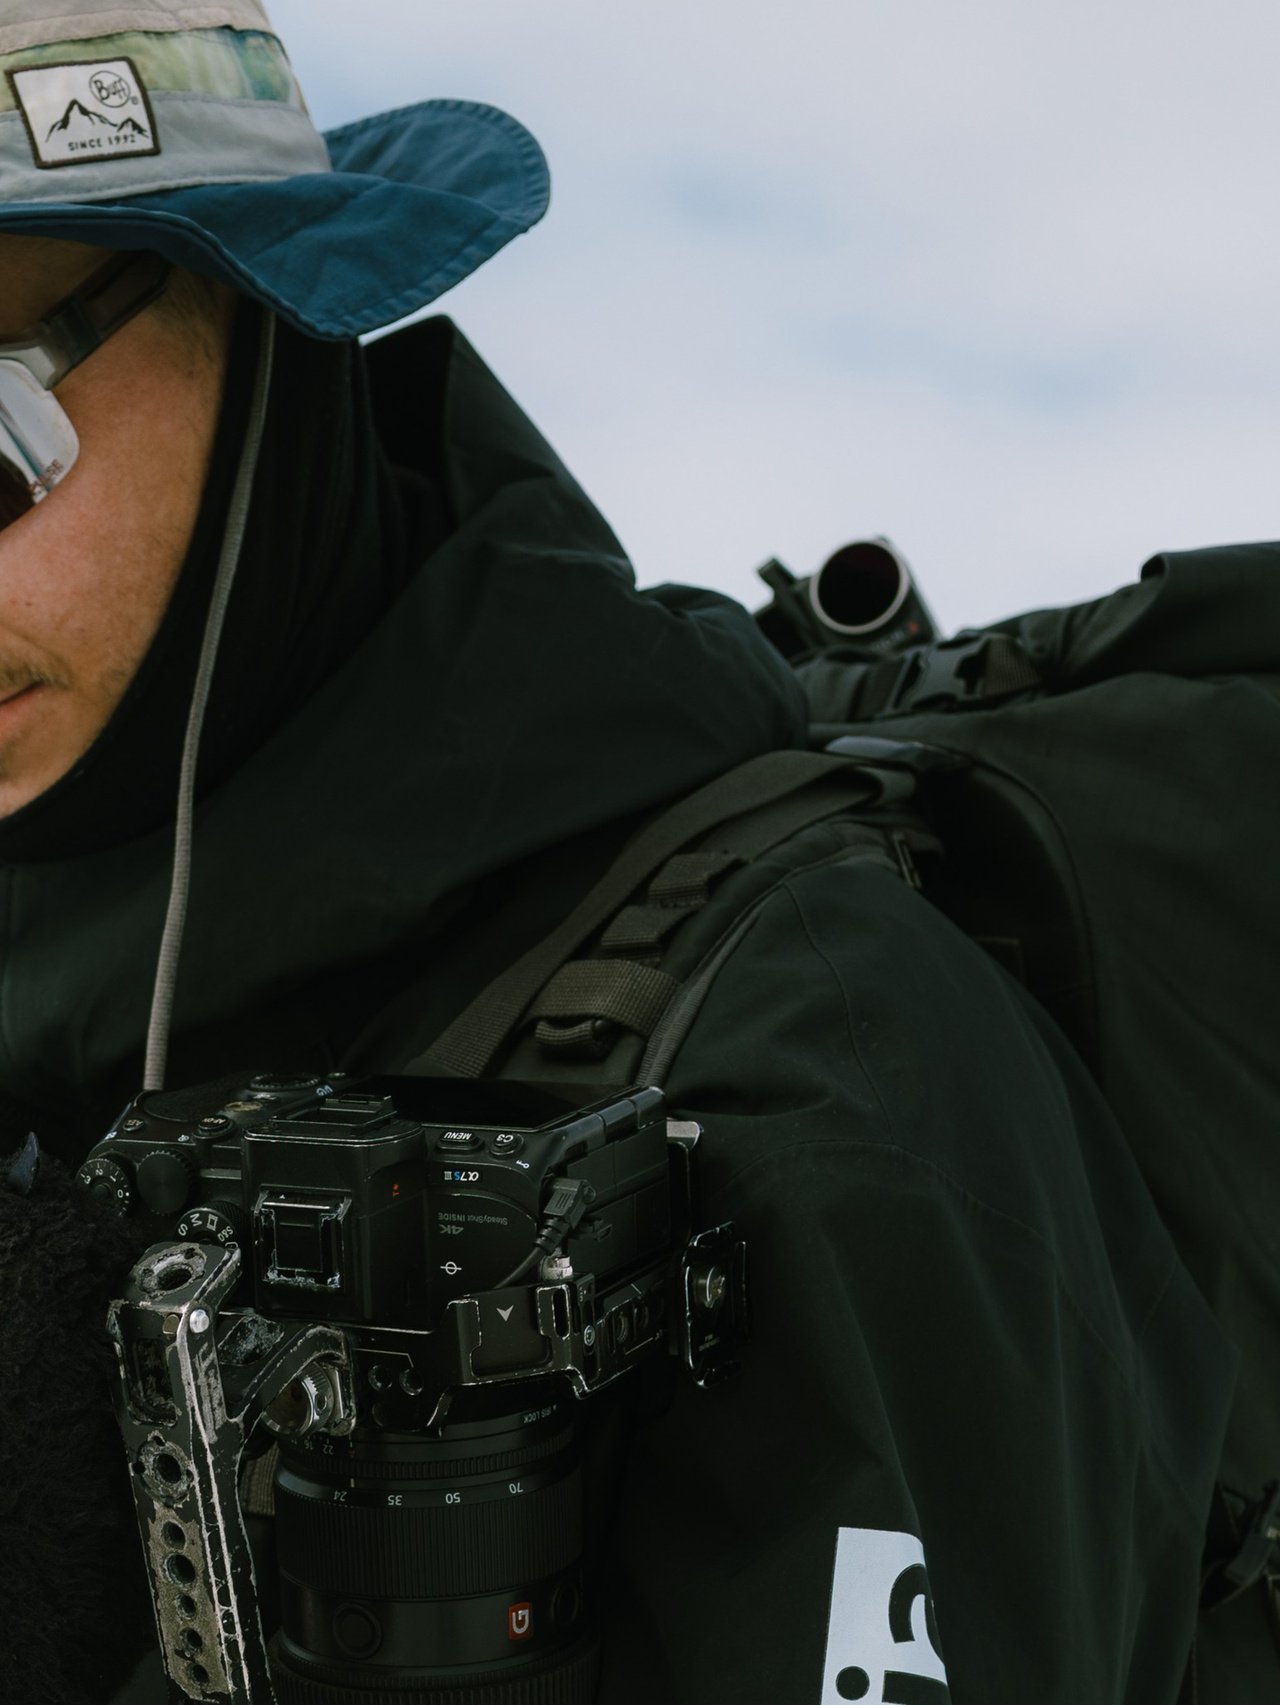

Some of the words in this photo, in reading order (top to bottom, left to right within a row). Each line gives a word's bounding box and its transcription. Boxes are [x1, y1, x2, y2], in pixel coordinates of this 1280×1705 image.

[68, 137, 102, 151] SINCE
[443, 1131, 473, 1140] MENU
[495, 1133, 514, 1143] C3
[437, 1212, 466, 1221] INSIDE
[177, 1223, 189, 1237] S
[189, 1213, 203, 1227] M
[438, 1223, 465, 1235] 4K
[322, 1443, 335, 1456] 22
[333, 1489, 348, 1502] 24
[387, 1494, 403, 1506] 35
[445, 1492, 461, 1504] 50
[508, 1481, 524, 1495] 70
